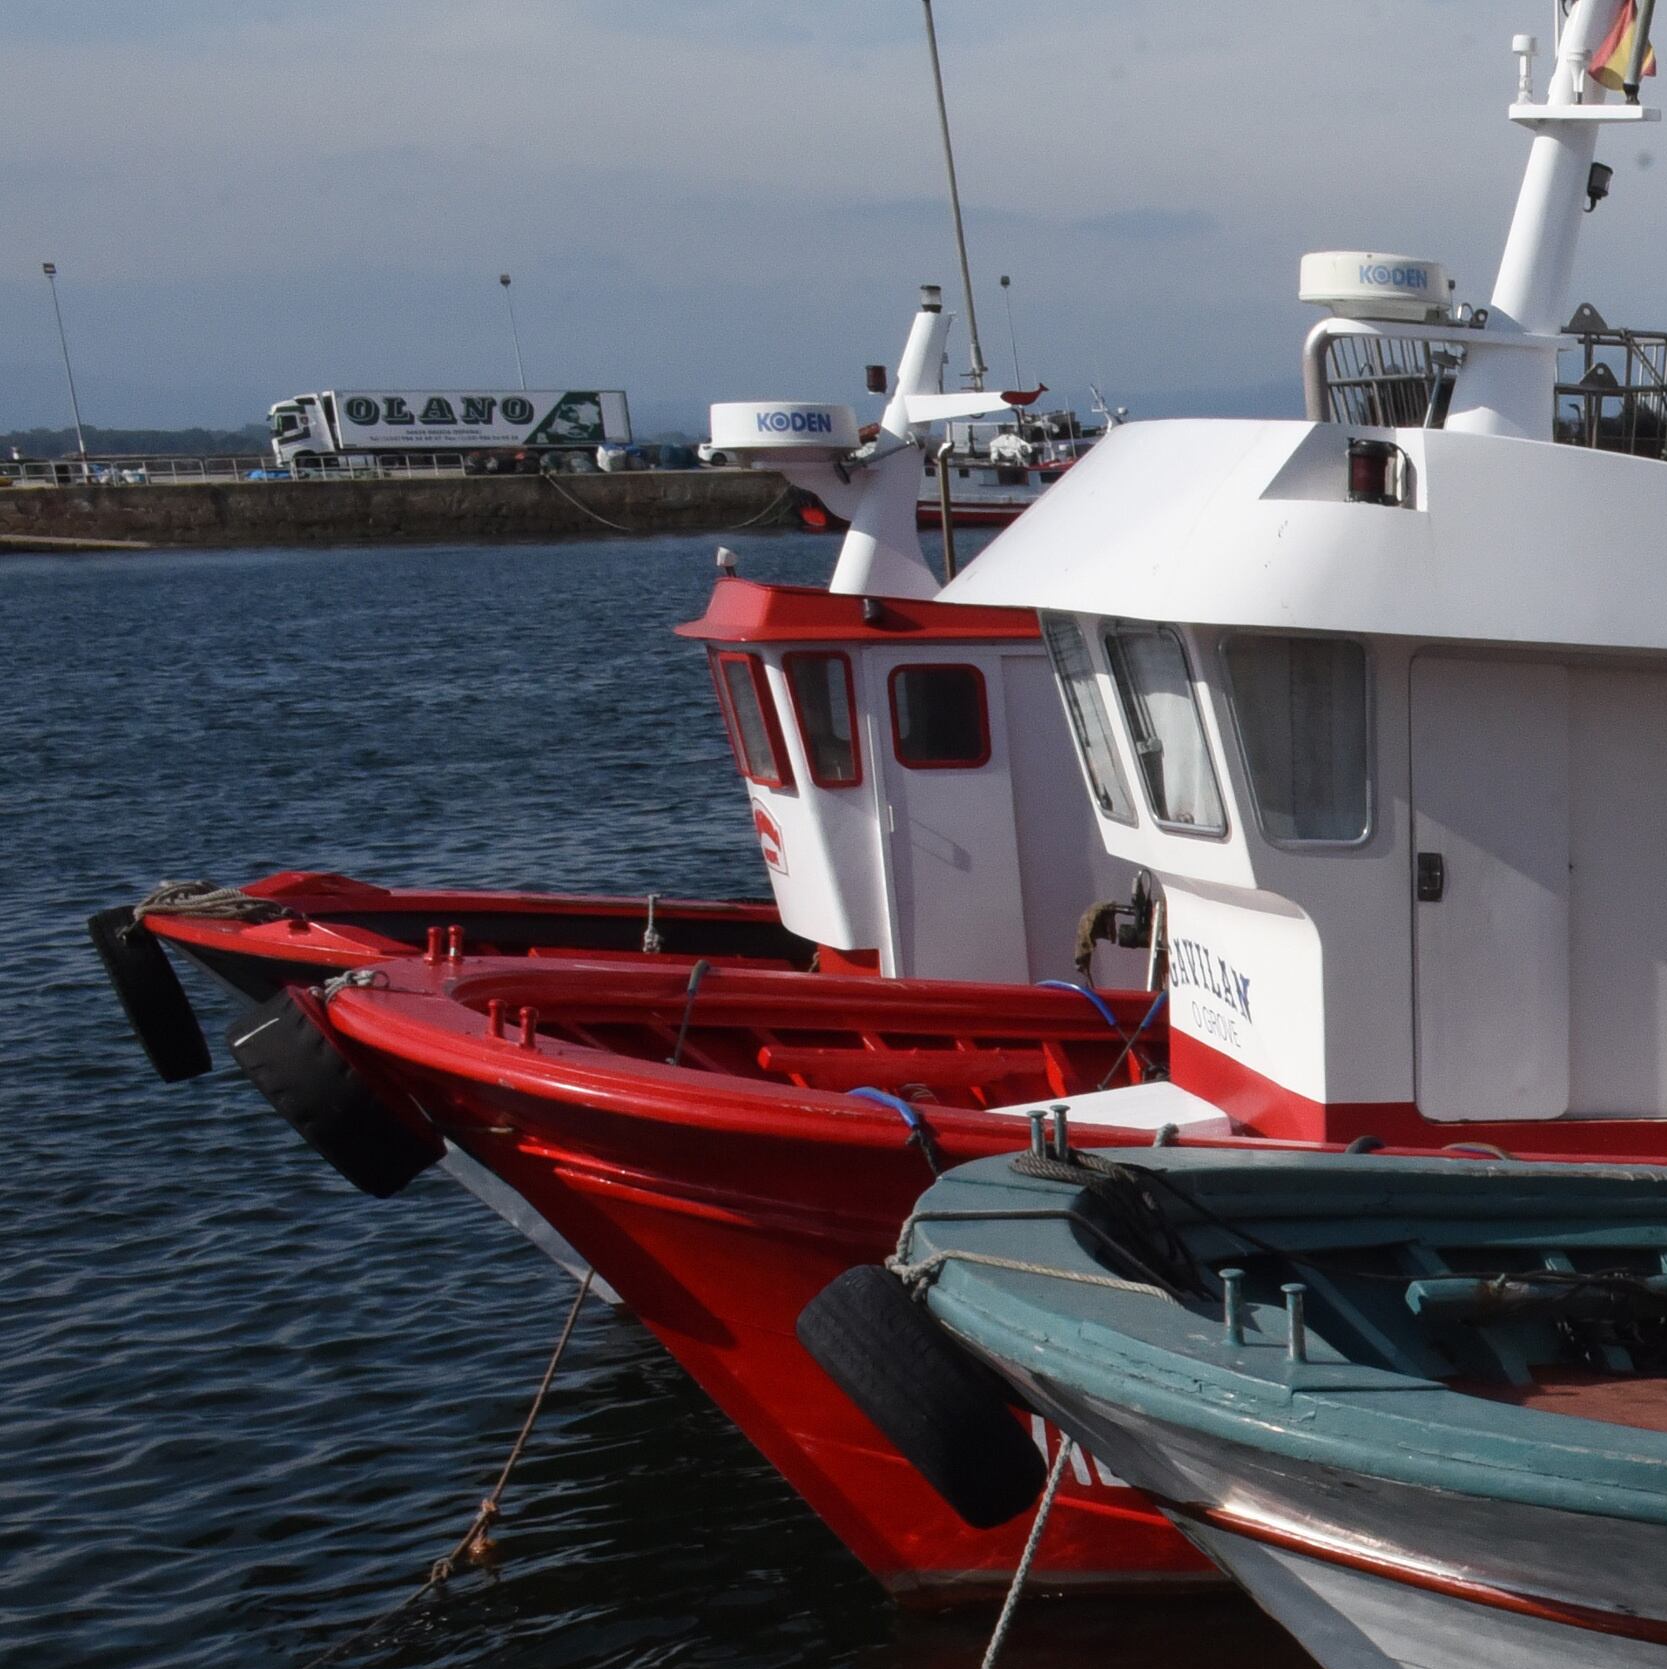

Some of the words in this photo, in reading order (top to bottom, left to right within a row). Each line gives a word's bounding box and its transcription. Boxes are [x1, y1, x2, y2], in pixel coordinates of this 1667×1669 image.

[1359, 264, 1428, 289] KODEN
[344, 395, 534, 426] OLANO
[756, 411, 832, 433] KODEN
[1192, 1000, 1202, 1028] O
